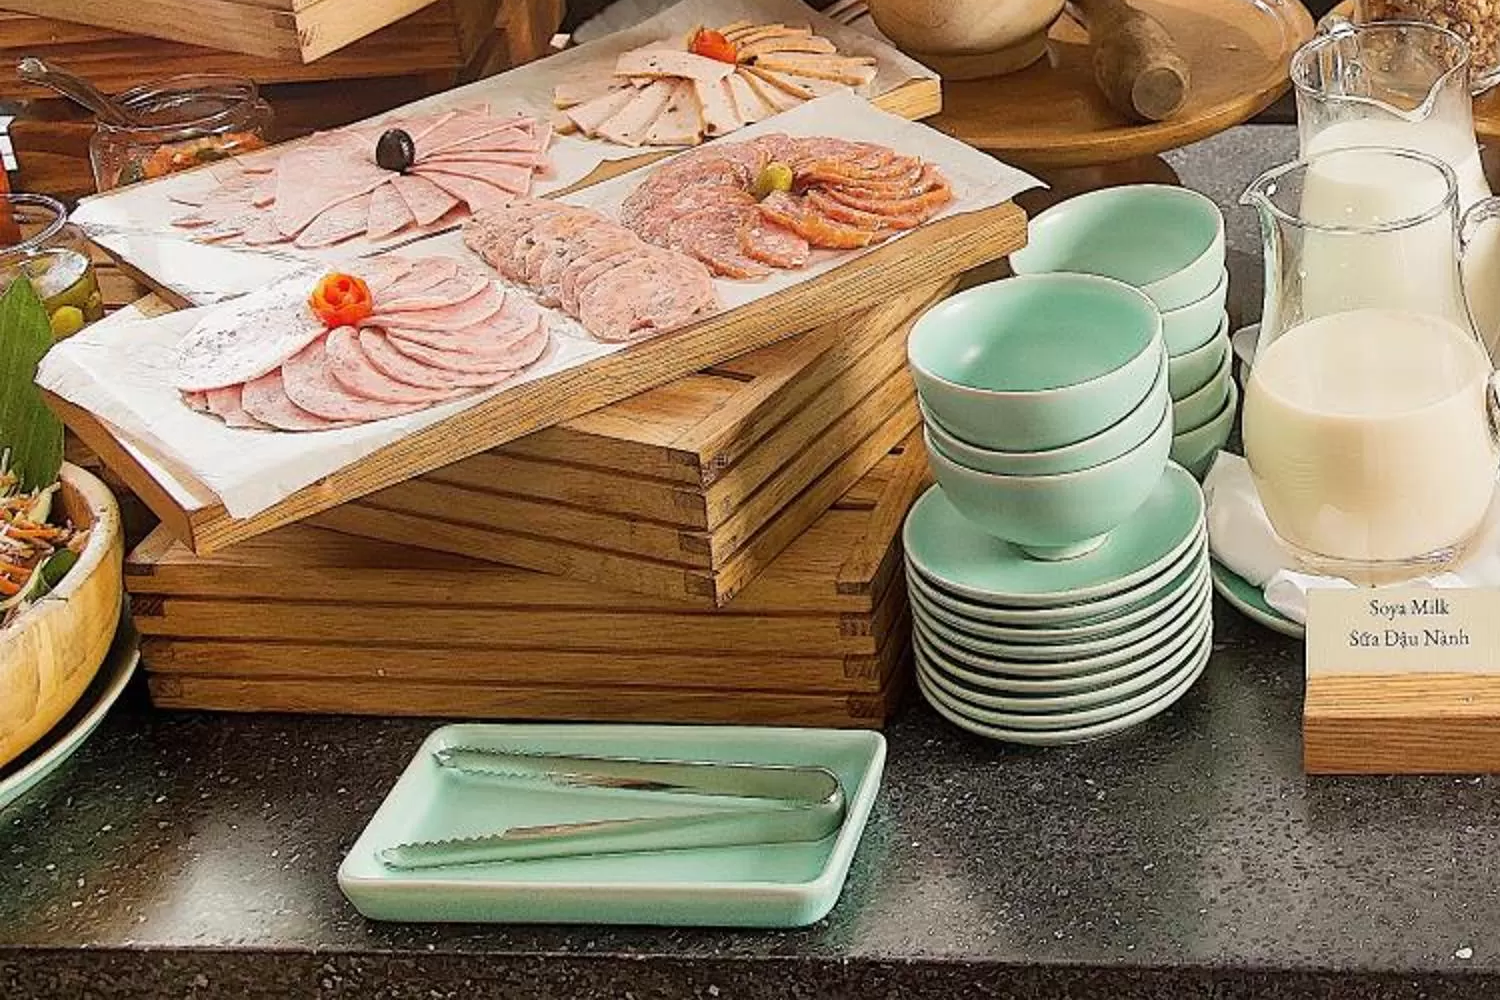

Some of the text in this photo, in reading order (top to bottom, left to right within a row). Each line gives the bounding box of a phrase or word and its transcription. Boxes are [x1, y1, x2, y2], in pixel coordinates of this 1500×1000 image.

[1369, 598, 1450, 621] Soya Milk
[1349, 629, 1379, 648] Sữa
[1423, 628, 1470, 648] Nành
